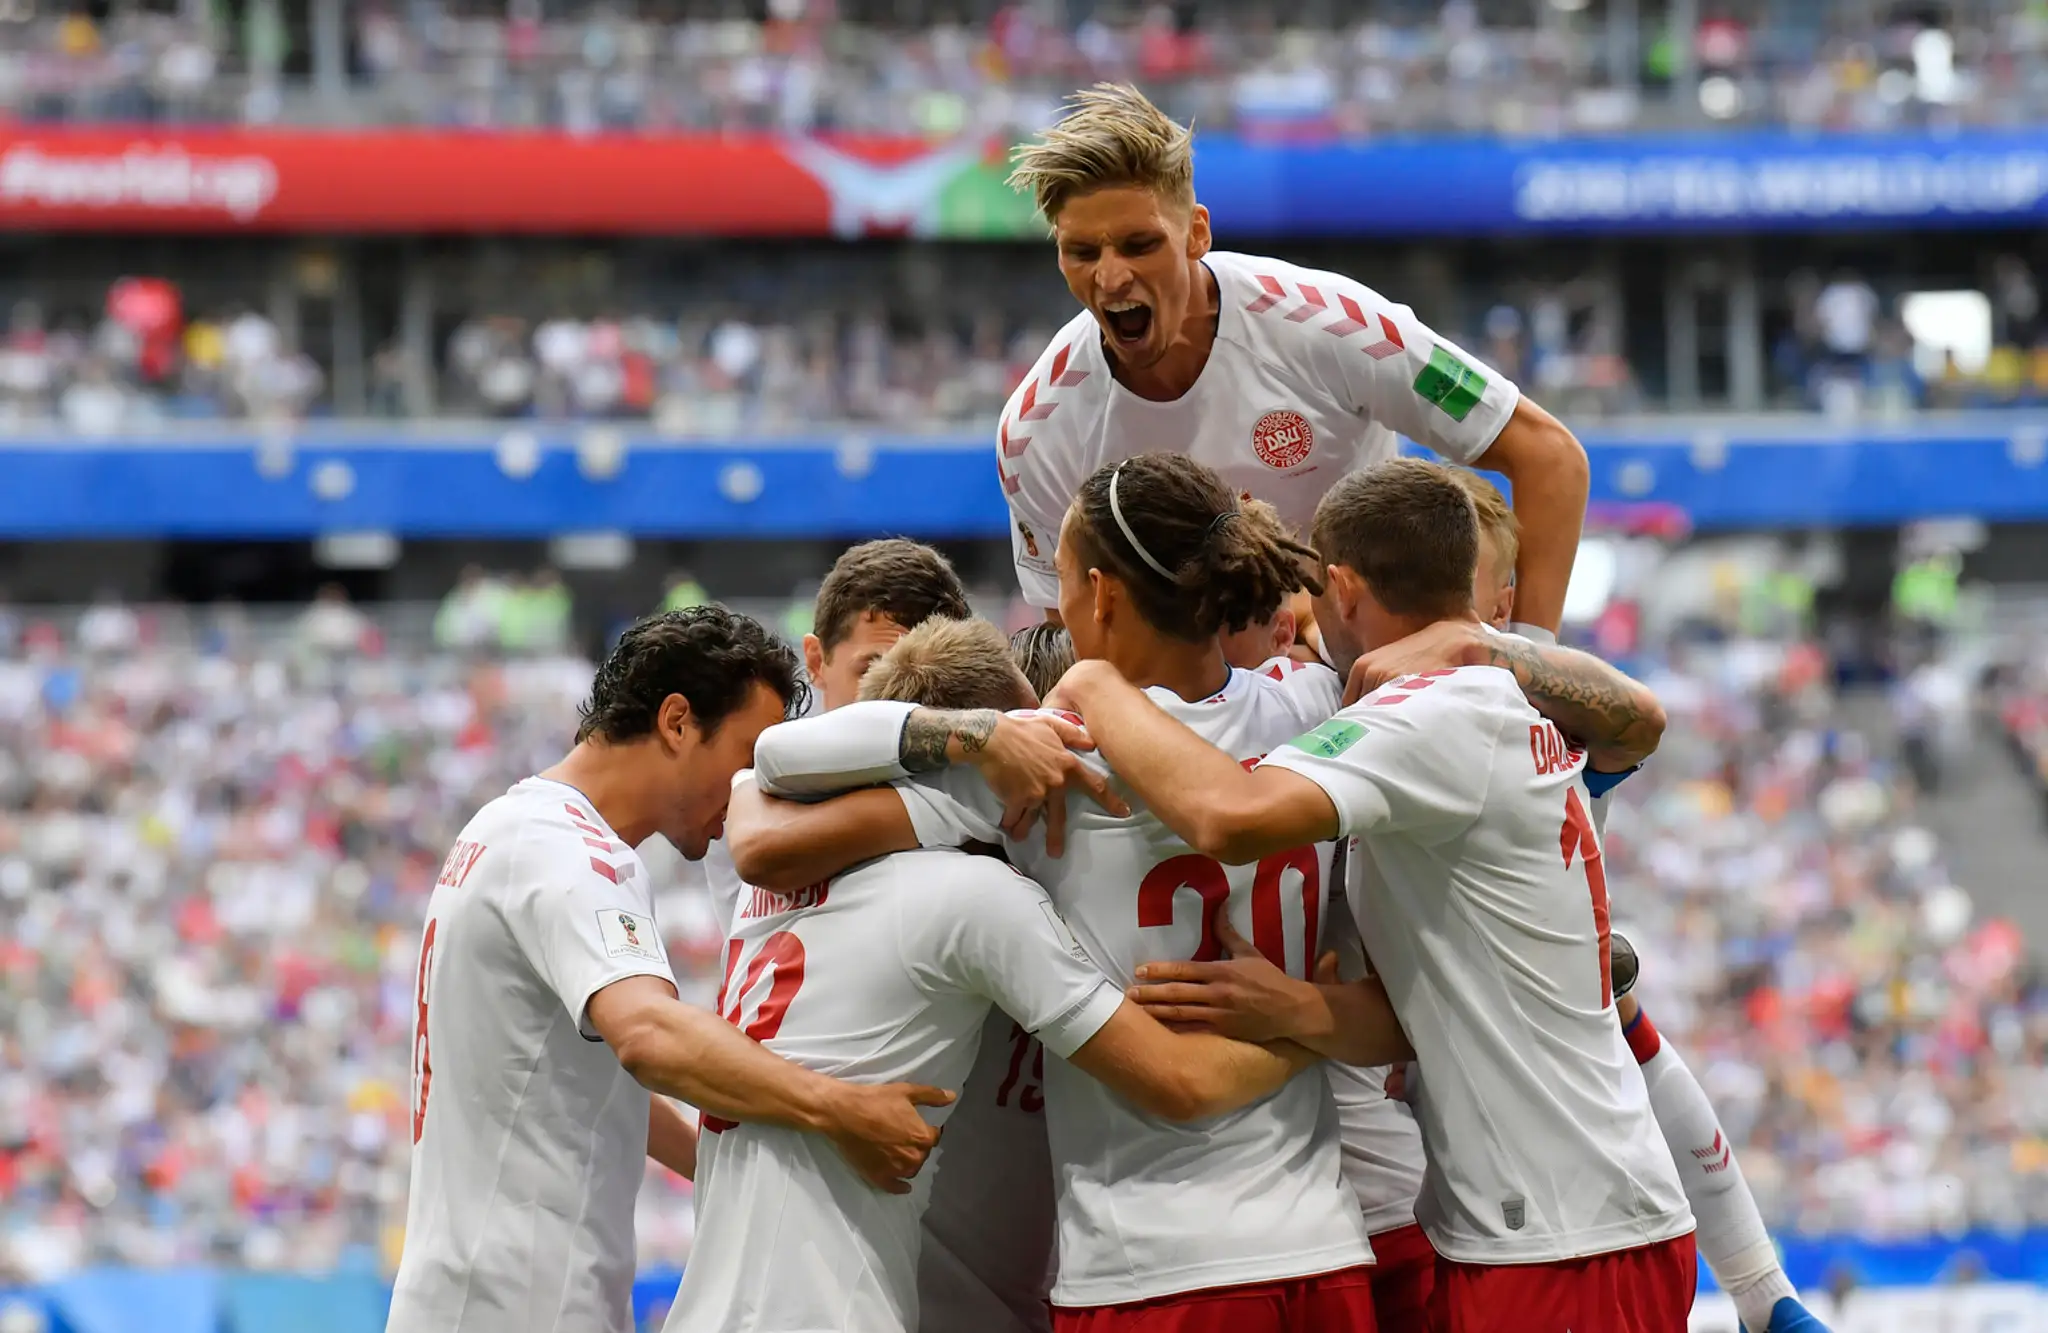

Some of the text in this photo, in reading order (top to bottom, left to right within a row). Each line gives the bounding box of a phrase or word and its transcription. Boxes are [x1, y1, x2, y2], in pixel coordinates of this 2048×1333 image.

[1264, 427, 1302, 452] DBU
[1137, 842, 1320, 981] 20
[413, 917, 437, 1146] 8
